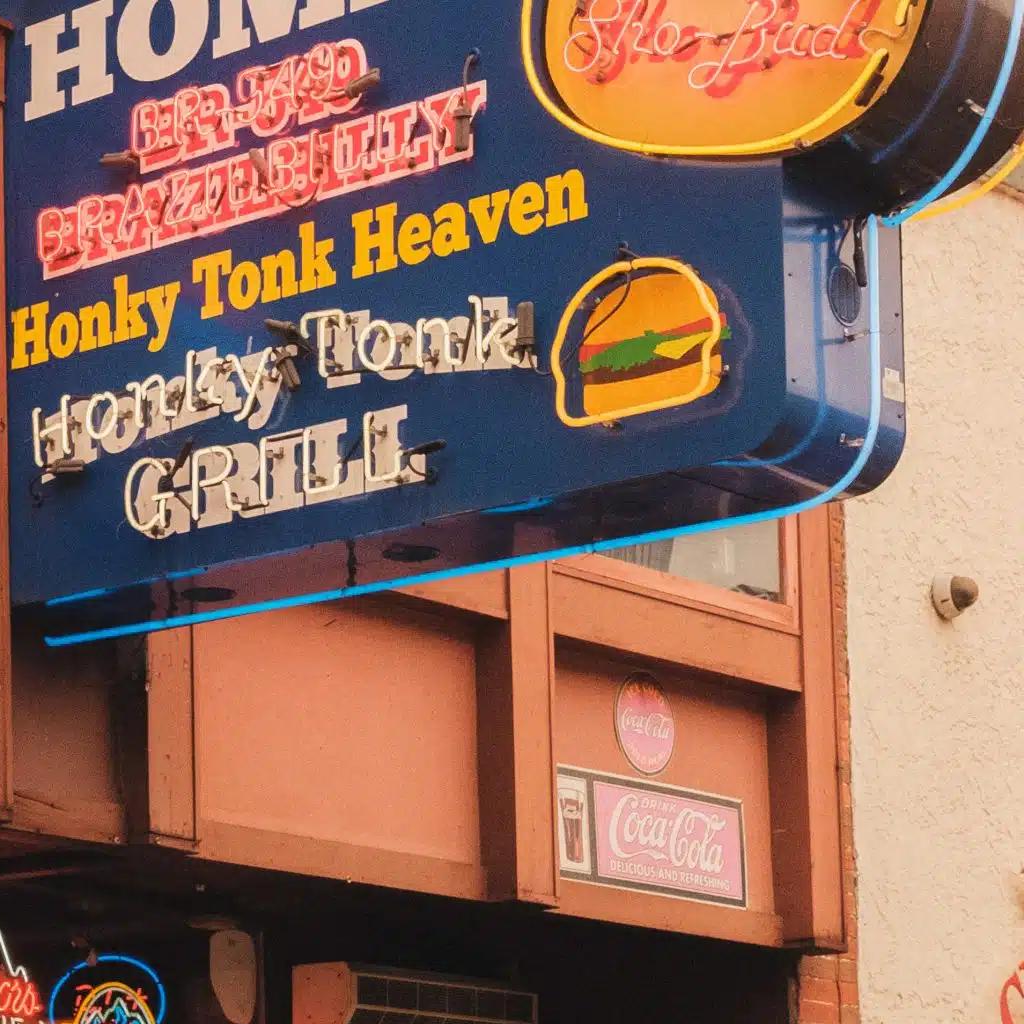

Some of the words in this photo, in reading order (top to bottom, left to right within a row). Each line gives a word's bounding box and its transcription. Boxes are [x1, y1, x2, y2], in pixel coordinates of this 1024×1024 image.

[24, 0, 388, 122] HOM
[10, 280, 181, 370] Honky
[191, 221, 339, 320] Tonk
[351, 166, 590, 281] Heaven
[33, 345, 301, 482] Honky
[301, 294, 538, 391] Tonk
[124, 404, 431, 541] GRILL
[608, 793, 727, 873] Coca-Cola
[640, 797, 677, 813] DRINK
[609, 858, 657, 880] DELICIOUS
[658, 868, 678, 882] AND
[679, 873, 732, 892] REFRESHING
